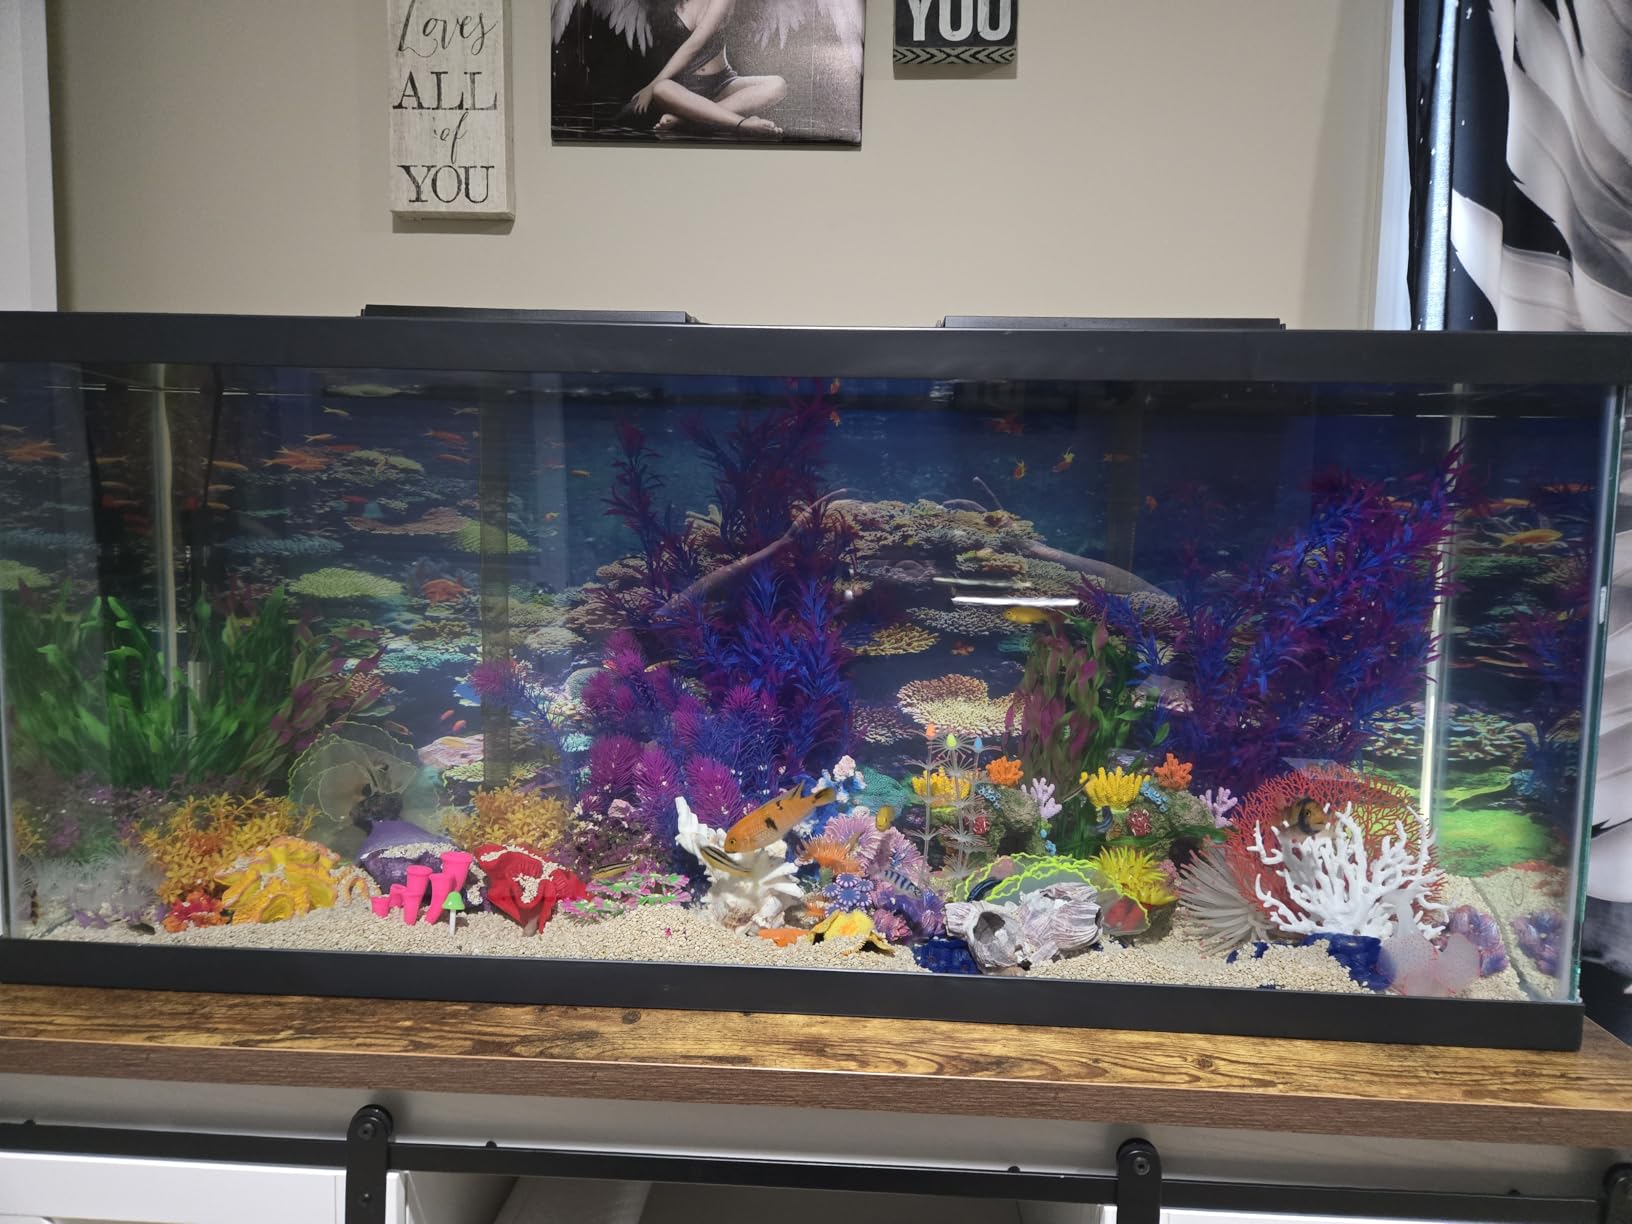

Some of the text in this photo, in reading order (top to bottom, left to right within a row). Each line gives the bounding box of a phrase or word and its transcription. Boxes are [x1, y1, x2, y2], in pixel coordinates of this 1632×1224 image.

[398, 0, 498, 58] Loves
[907, 0, 1012, 42] YOU
[392, 71, 497, 110] ALL
[439, 111, 468, 164] of
[397, 165, 495, 203] YOU
